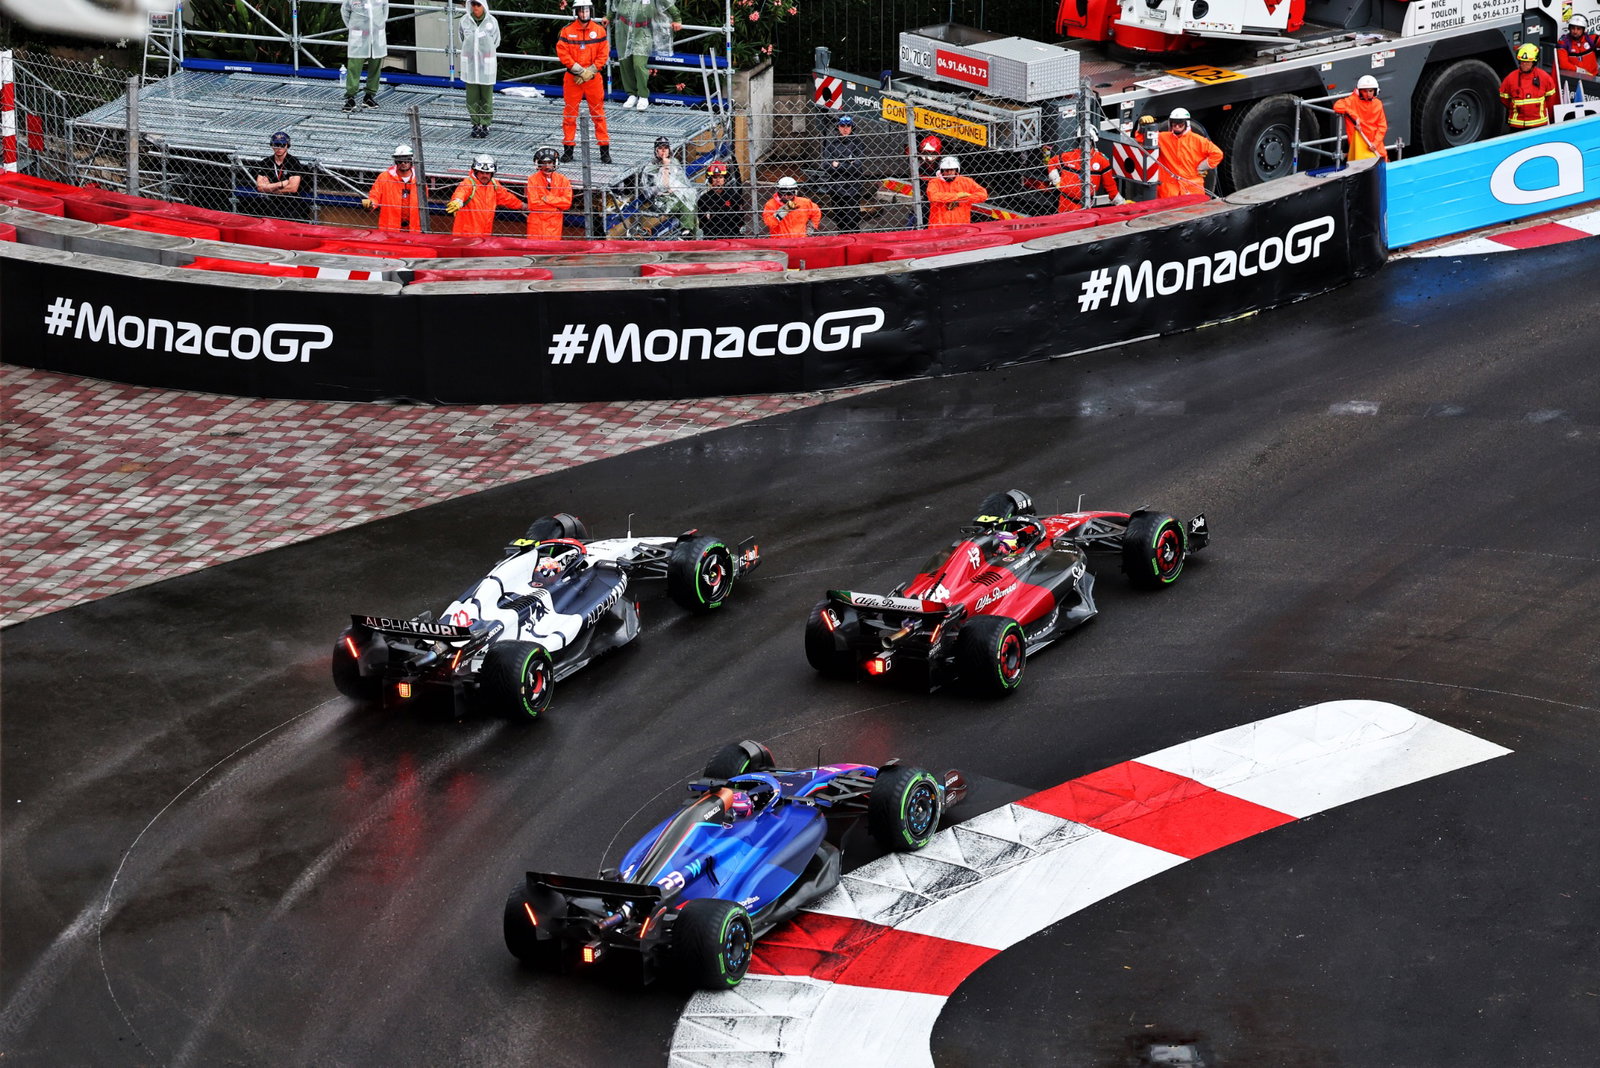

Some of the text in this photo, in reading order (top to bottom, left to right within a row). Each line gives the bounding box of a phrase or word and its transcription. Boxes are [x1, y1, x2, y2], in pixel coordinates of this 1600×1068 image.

[1431, 0, 1520, 19] TOULON 04.94.03..
[1431, 5, 1519, 30] MARSEILLE 04.91.64.13.73
[937, 57, 987, 78] 04.91.64.13.73
[886, 103, 919, 122] CONI
[1078, 215, 1335, 313] #MonacoGP
[44, 296, 334, 363] #MonacoGP
[548, 306, 886, 365] #MonacoGP
[855, 596, 920, 611] Alfa Romeo
[365, 616, 458, 636] ALPHATAURI
